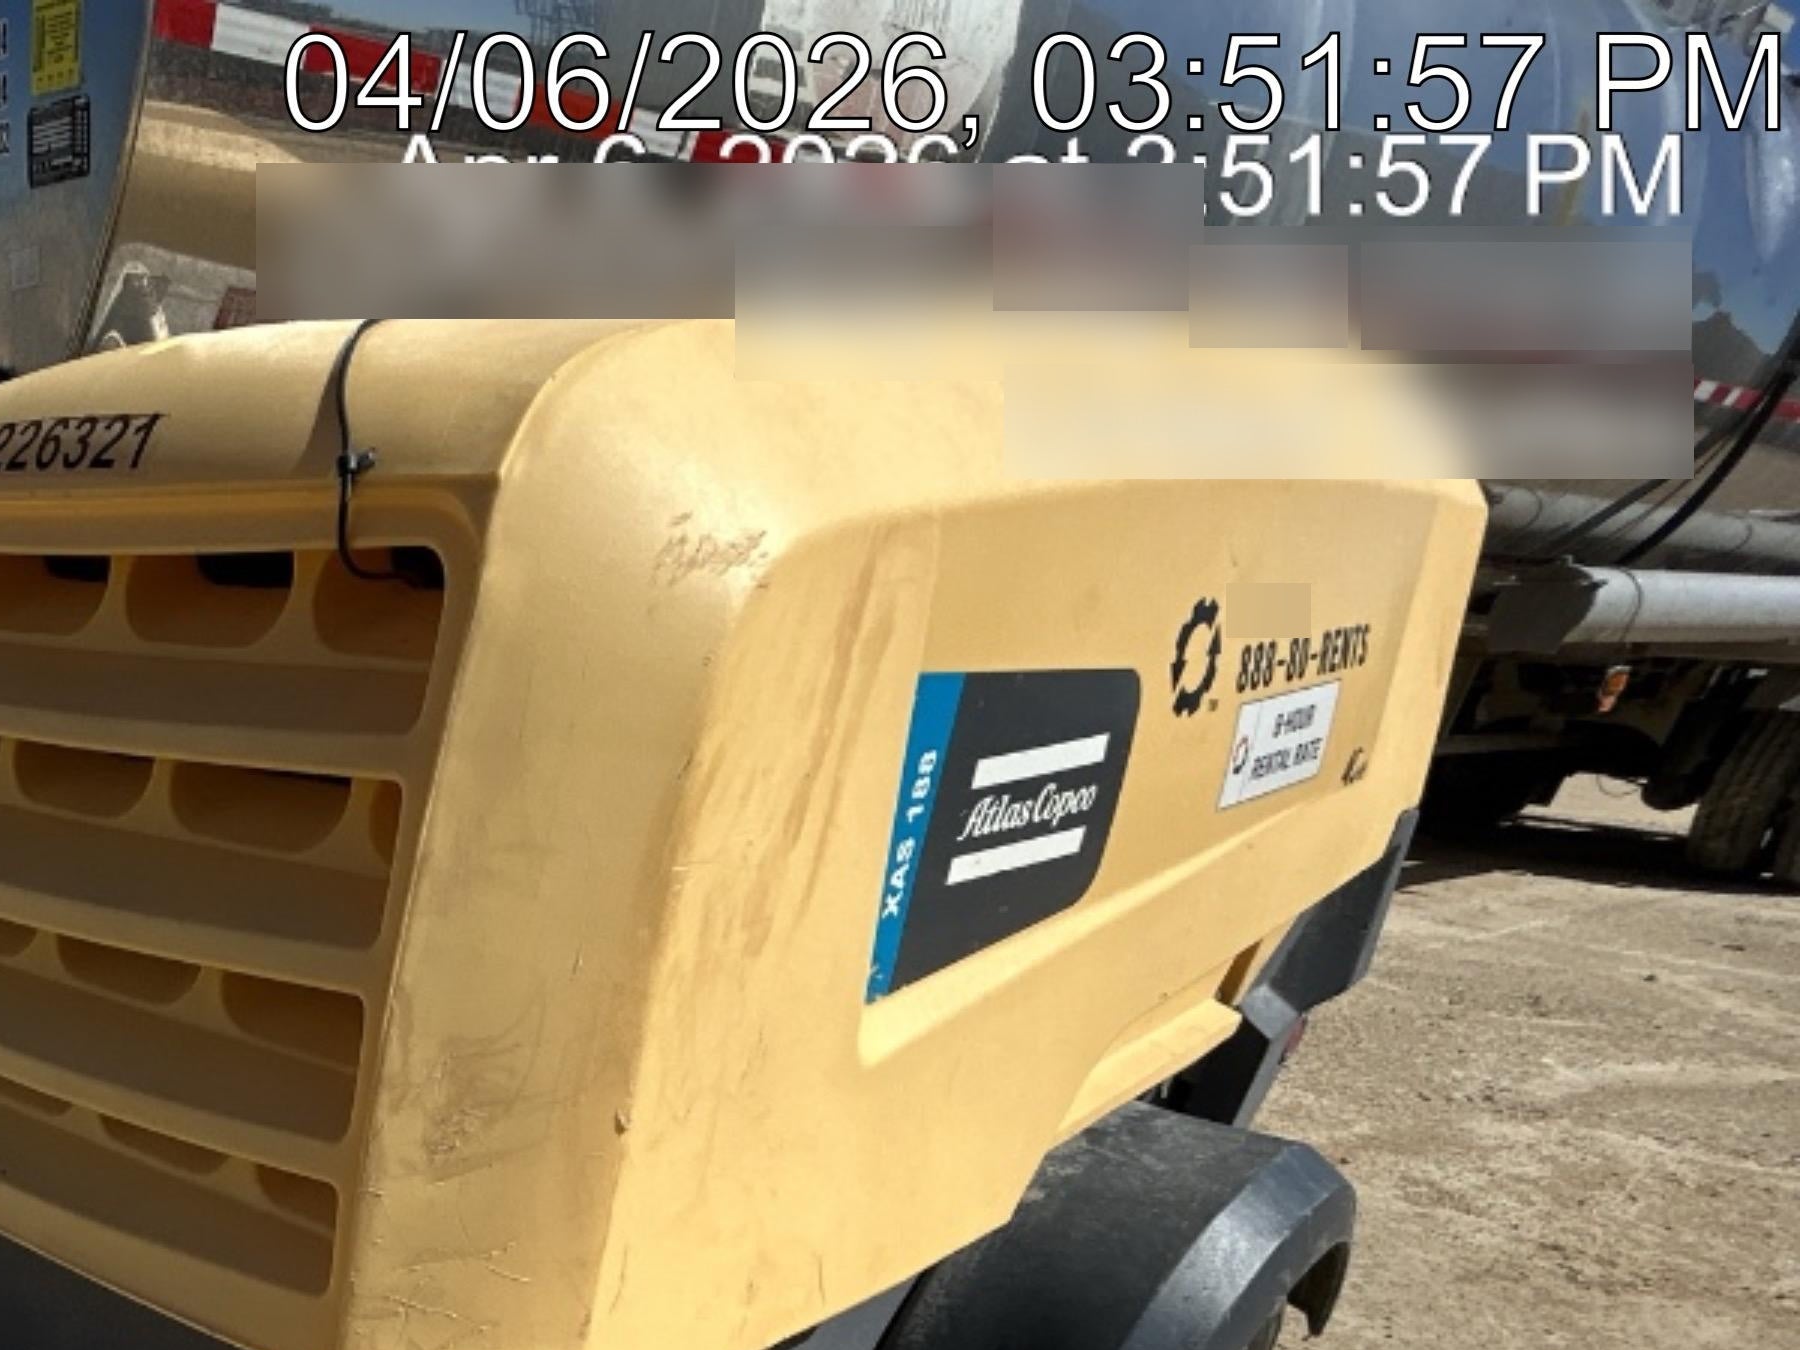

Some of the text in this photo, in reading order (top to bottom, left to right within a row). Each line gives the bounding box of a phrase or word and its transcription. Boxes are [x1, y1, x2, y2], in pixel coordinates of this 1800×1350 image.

[1249, 737, 1323, 780] RENTAL RATE
[882, 749, 937, 919] XAS 188
[954, 782, 1098, 842] Atlas Copco
